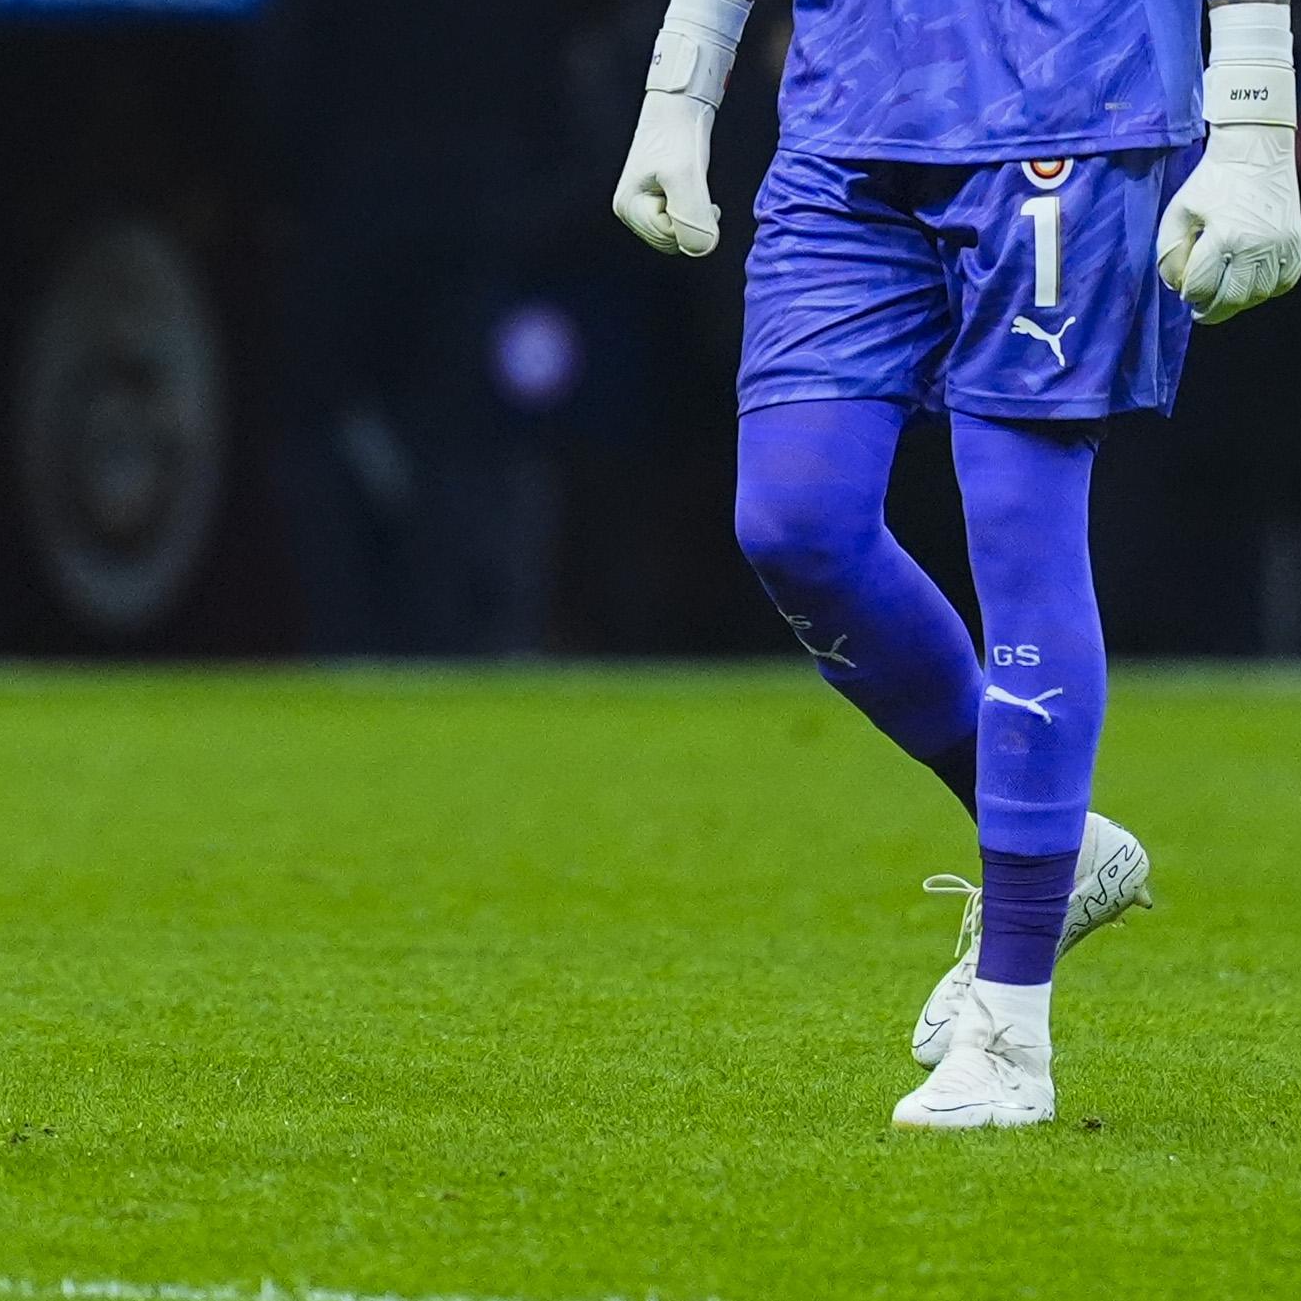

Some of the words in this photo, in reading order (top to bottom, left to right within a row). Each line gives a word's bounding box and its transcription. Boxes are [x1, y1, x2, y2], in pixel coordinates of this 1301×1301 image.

[1229, 86, 1269, 101] ÇAKIR
[1020, 196, 1060, 307] 1
[993, 644, 1040, 667] GS
